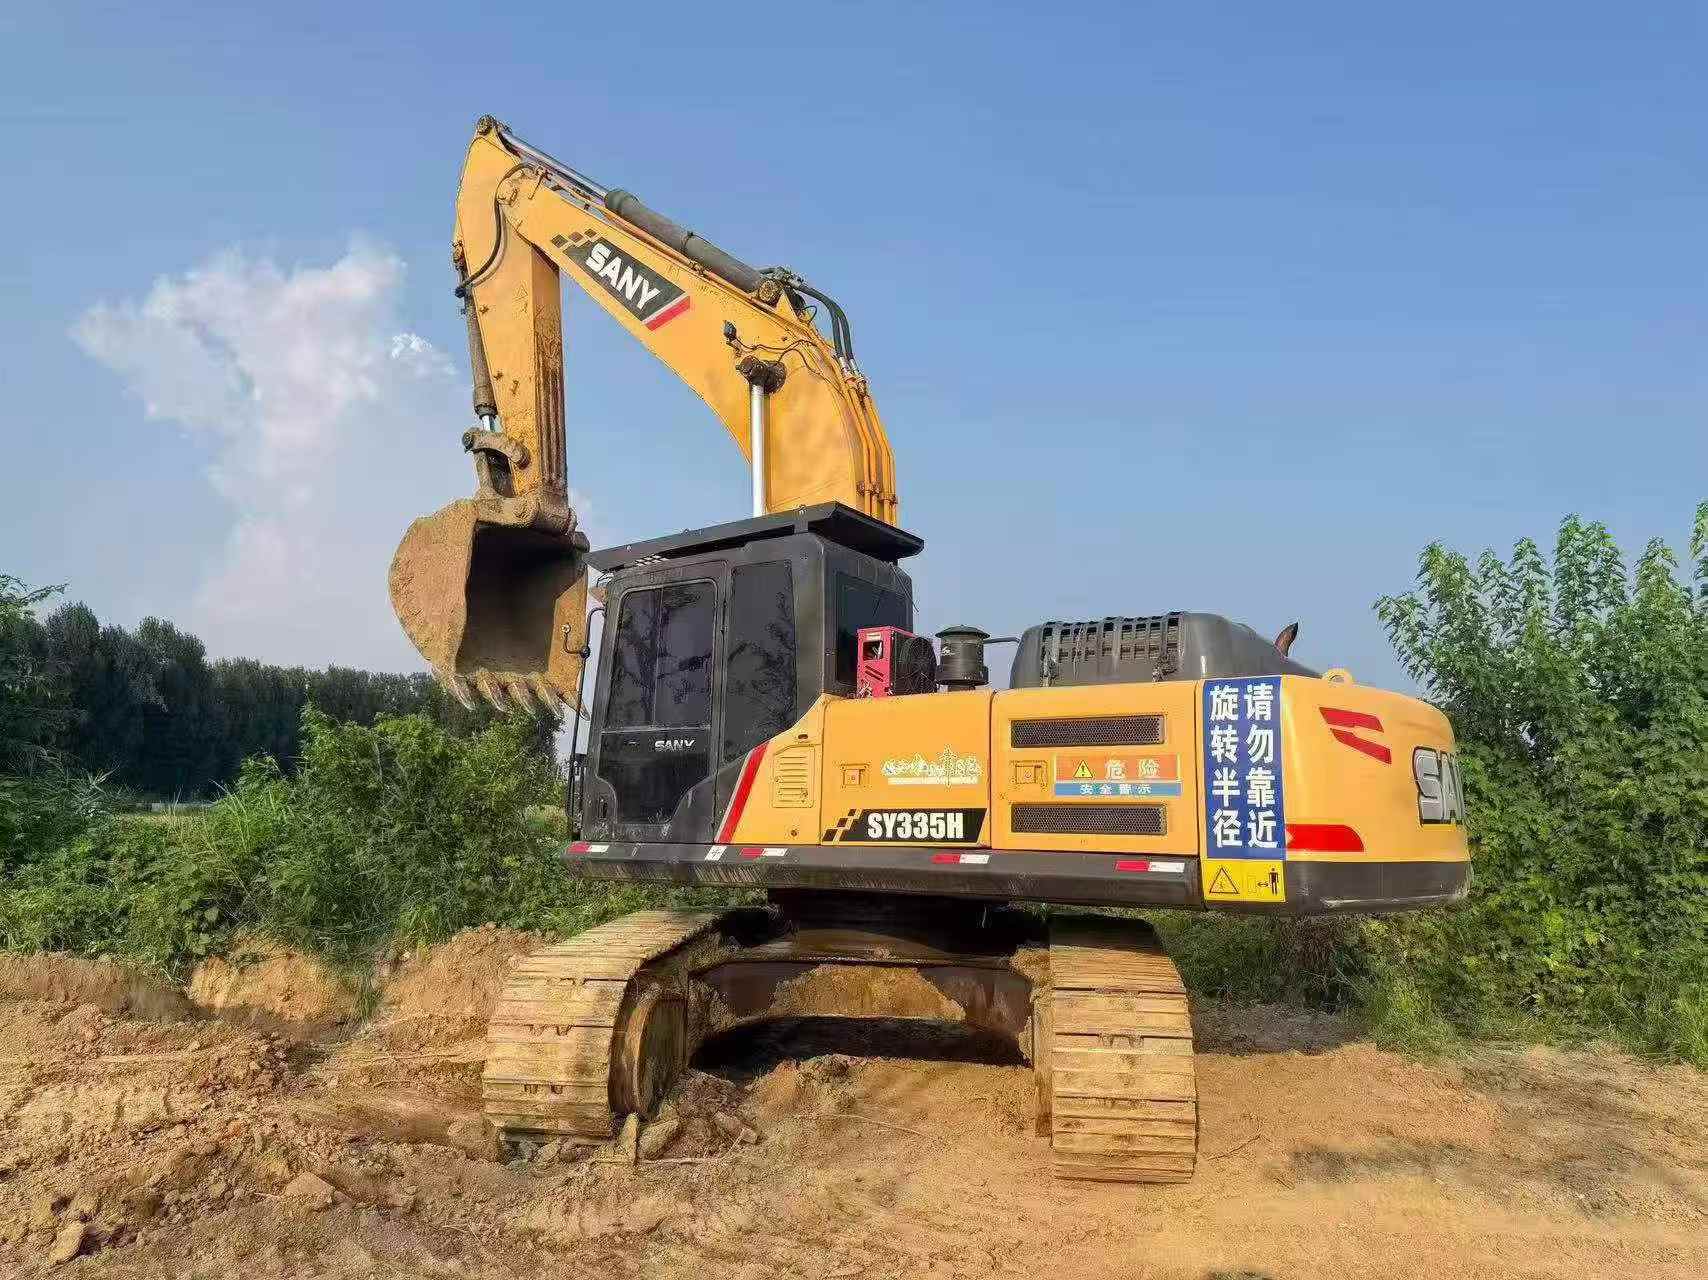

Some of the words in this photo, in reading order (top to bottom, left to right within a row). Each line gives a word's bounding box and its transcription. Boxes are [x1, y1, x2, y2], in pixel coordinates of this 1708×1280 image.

[585, 242, 661, 310] SANY
[654, 740, 695, 752] SANY
[1210, 684, 1242, 848] 旋转半径
[1244, 683, 1278, 848] 请勿靠近
[867, 812, 964, 840] SY335H
